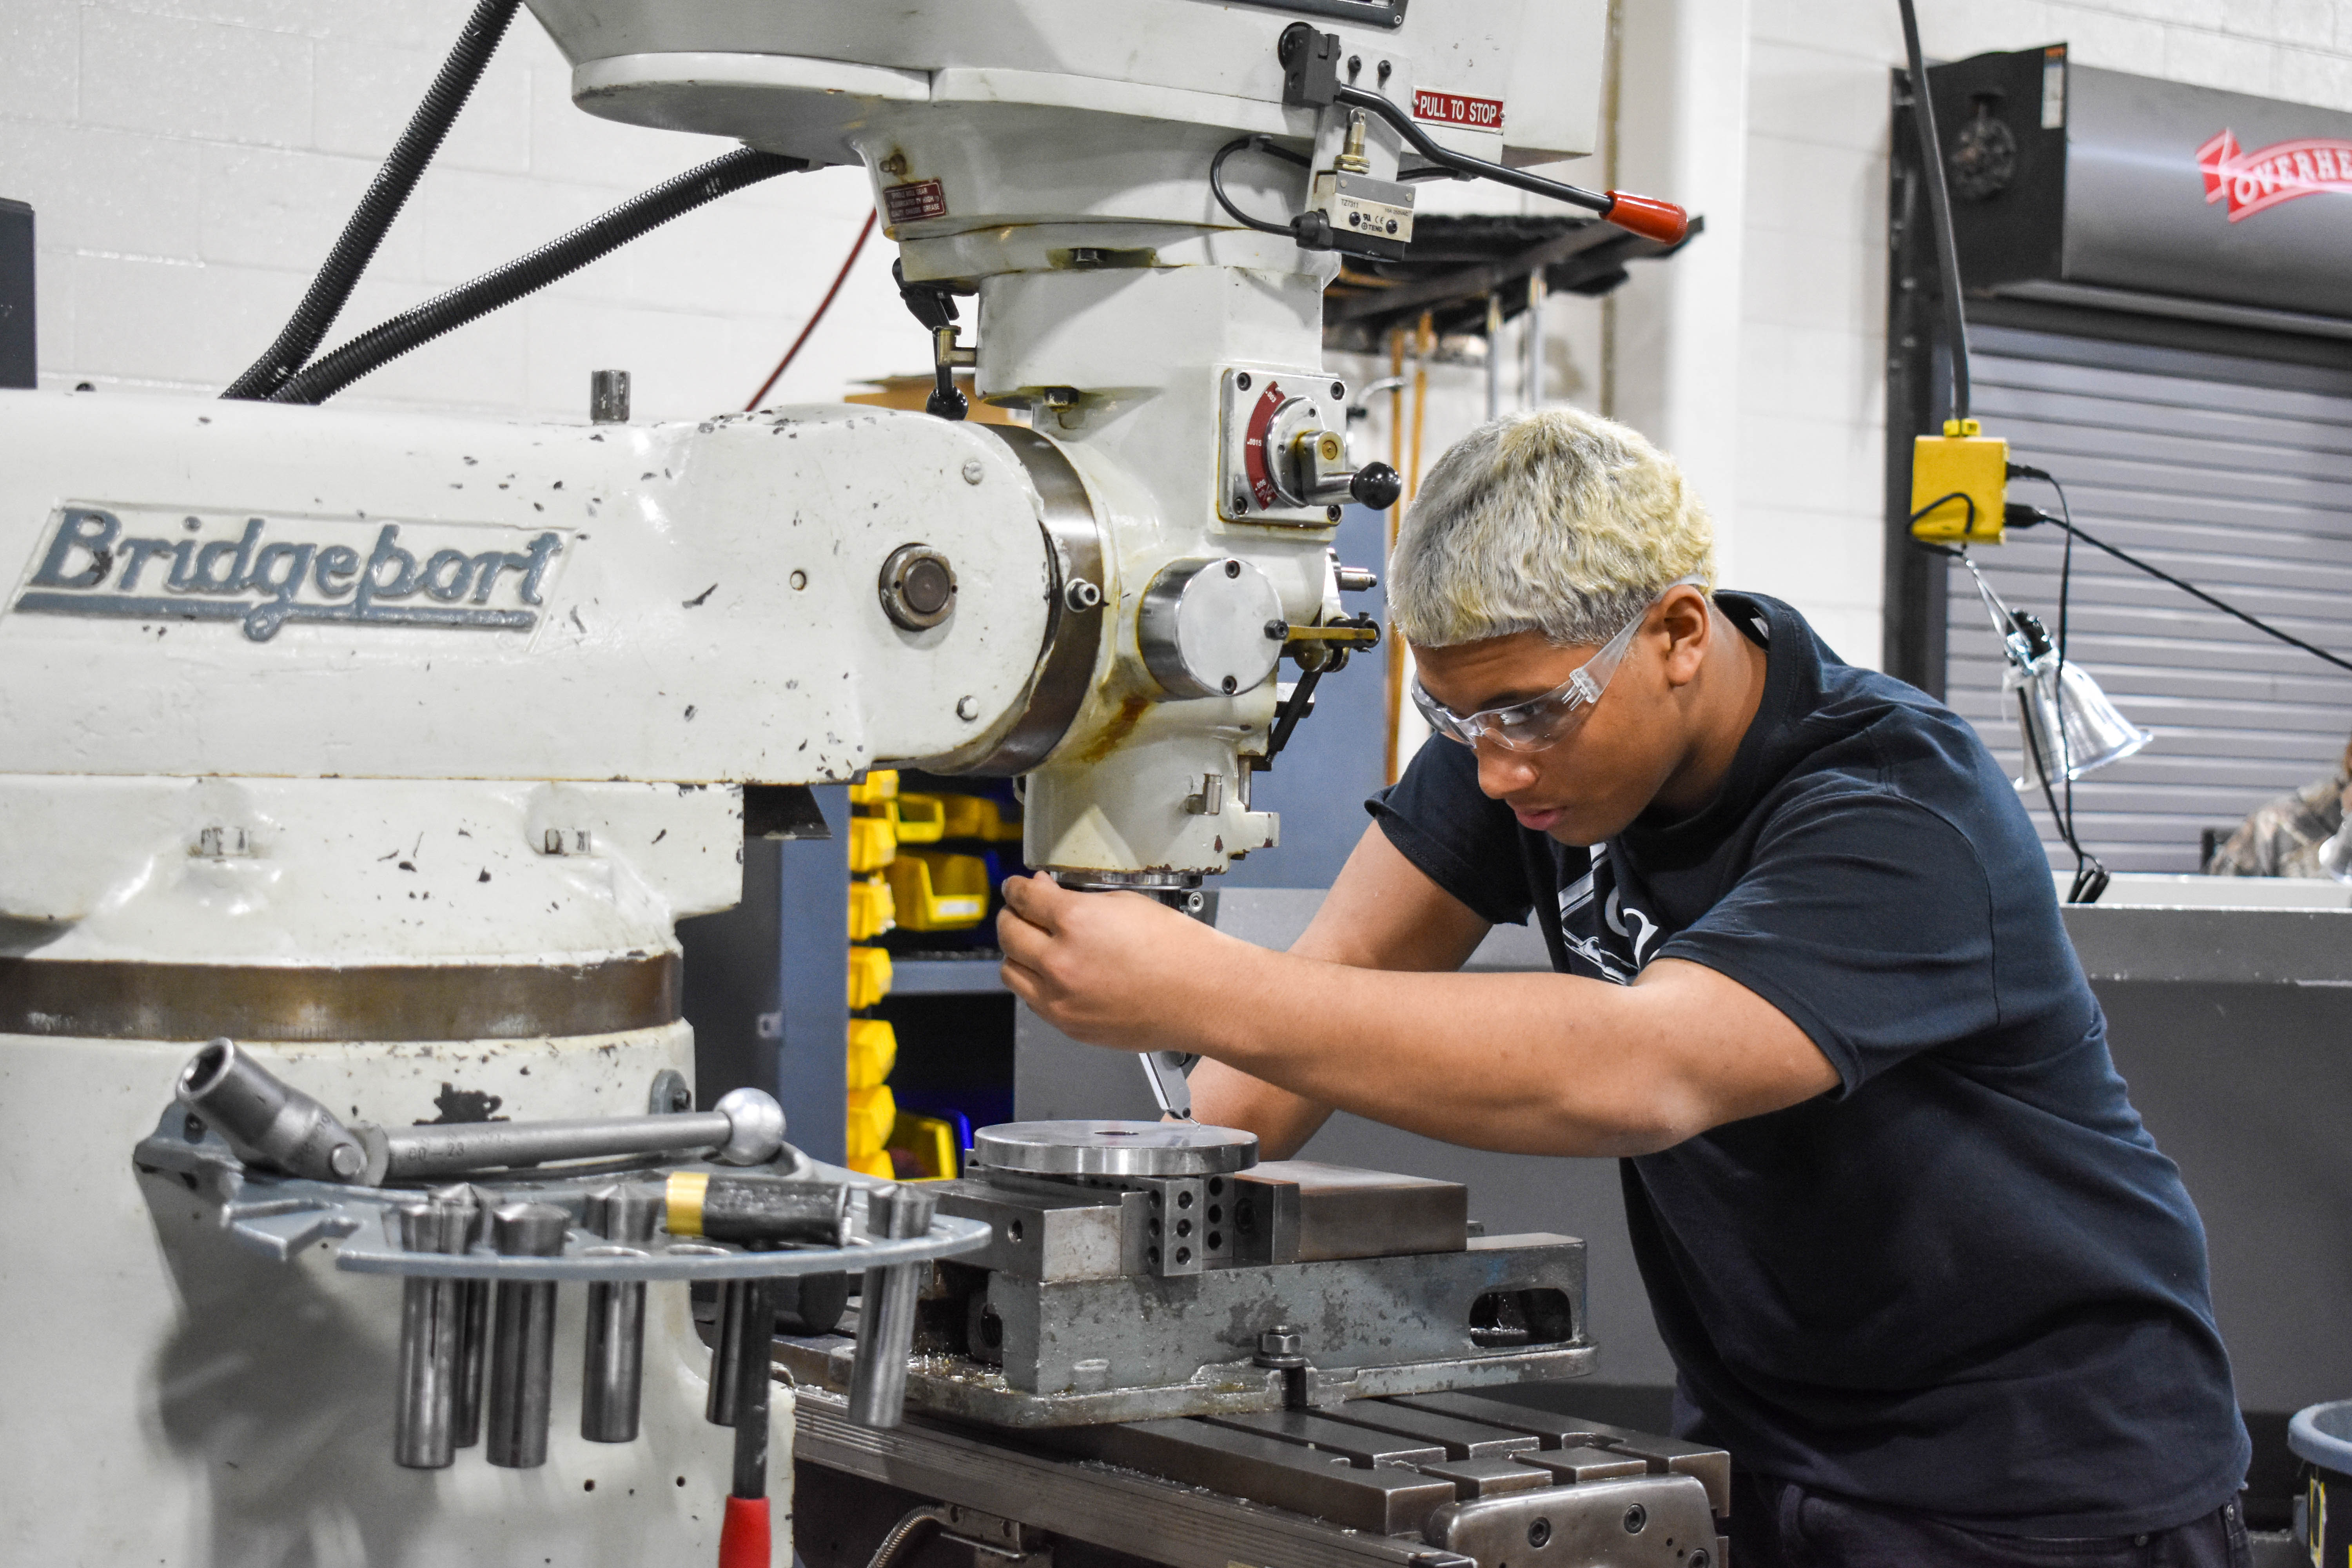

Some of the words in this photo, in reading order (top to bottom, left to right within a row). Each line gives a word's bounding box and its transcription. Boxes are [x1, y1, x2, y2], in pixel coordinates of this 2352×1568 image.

[1419, 95, 1446, 118] PULL
[1451, 99, 1465, 120] TO
[1469, 102, 1497, 124] STOP
[923, 203, 940, 212] GREASE
[1341, 199, 1359, 208] TZ7311
[1265, 390, 1277, 403] .003
[1247, 438, 1262, 447] .0015
[1255, 479, 1266, 491] .006
[29, 506, 564, 643] Bridgeport
